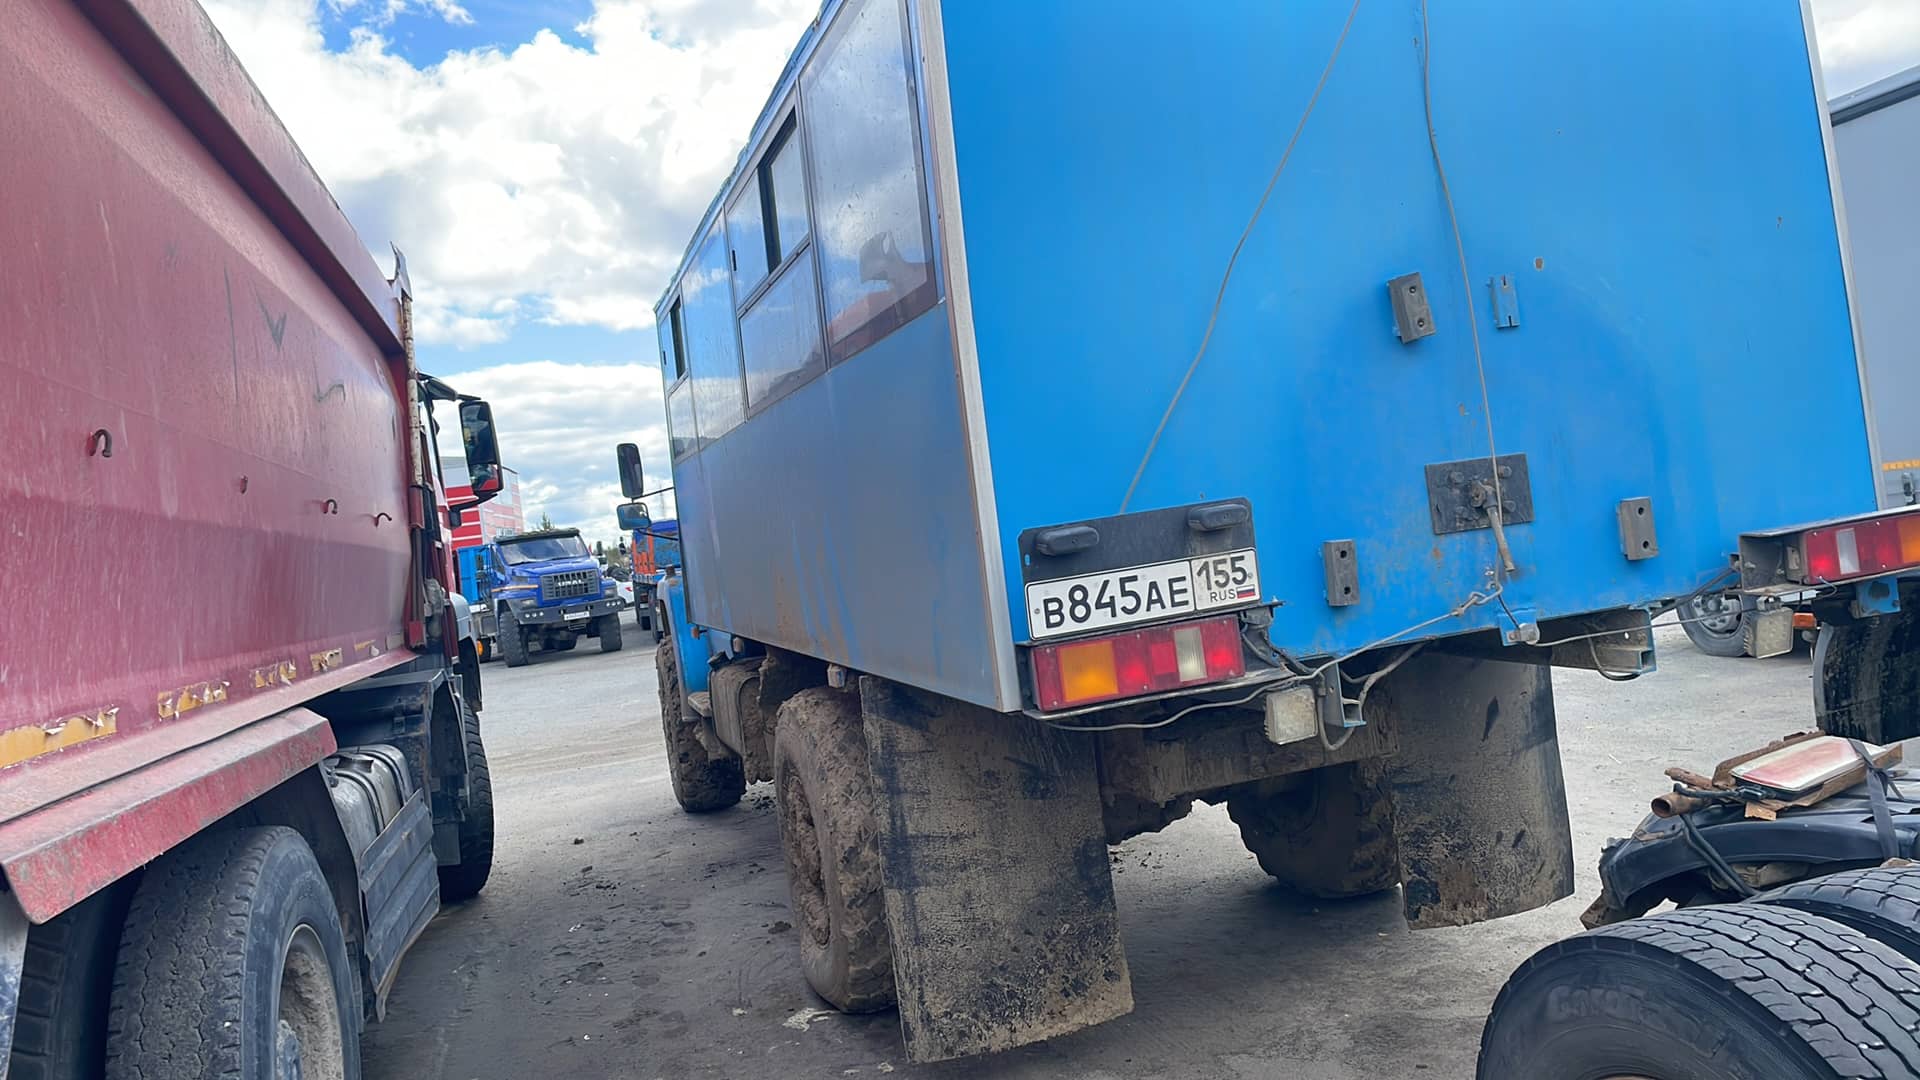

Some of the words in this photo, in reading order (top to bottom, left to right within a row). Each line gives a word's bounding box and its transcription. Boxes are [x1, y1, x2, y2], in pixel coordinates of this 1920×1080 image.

[1043, 575, 1189, 629] В845АЕ
[1197, 555, 1248, 591] 155
[1209, 588, 1236, 603] RUS
